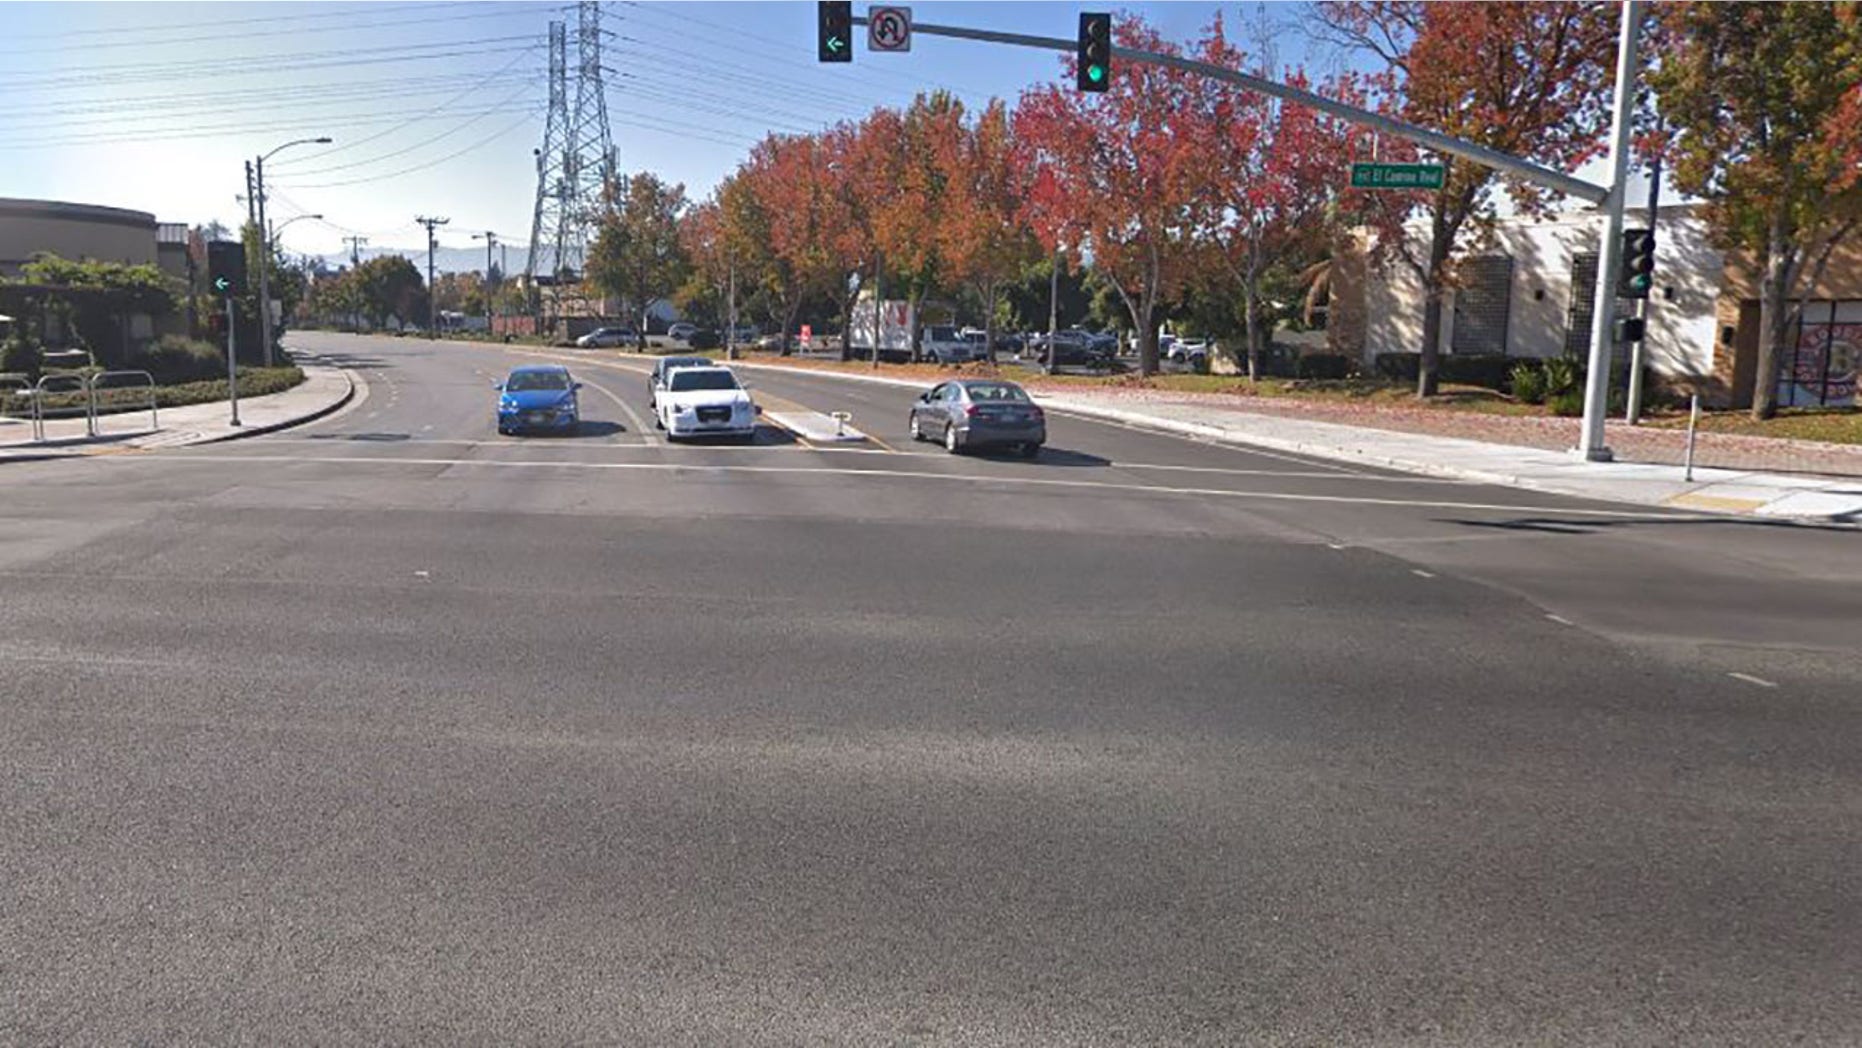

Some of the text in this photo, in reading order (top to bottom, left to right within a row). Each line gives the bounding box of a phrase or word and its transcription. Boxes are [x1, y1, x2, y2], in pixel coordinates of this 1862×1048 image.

[1373, 168, 1382, 182] El
[1385, 168, 1416, 183] Camino
[1419, 169, 1439, 184] Real
